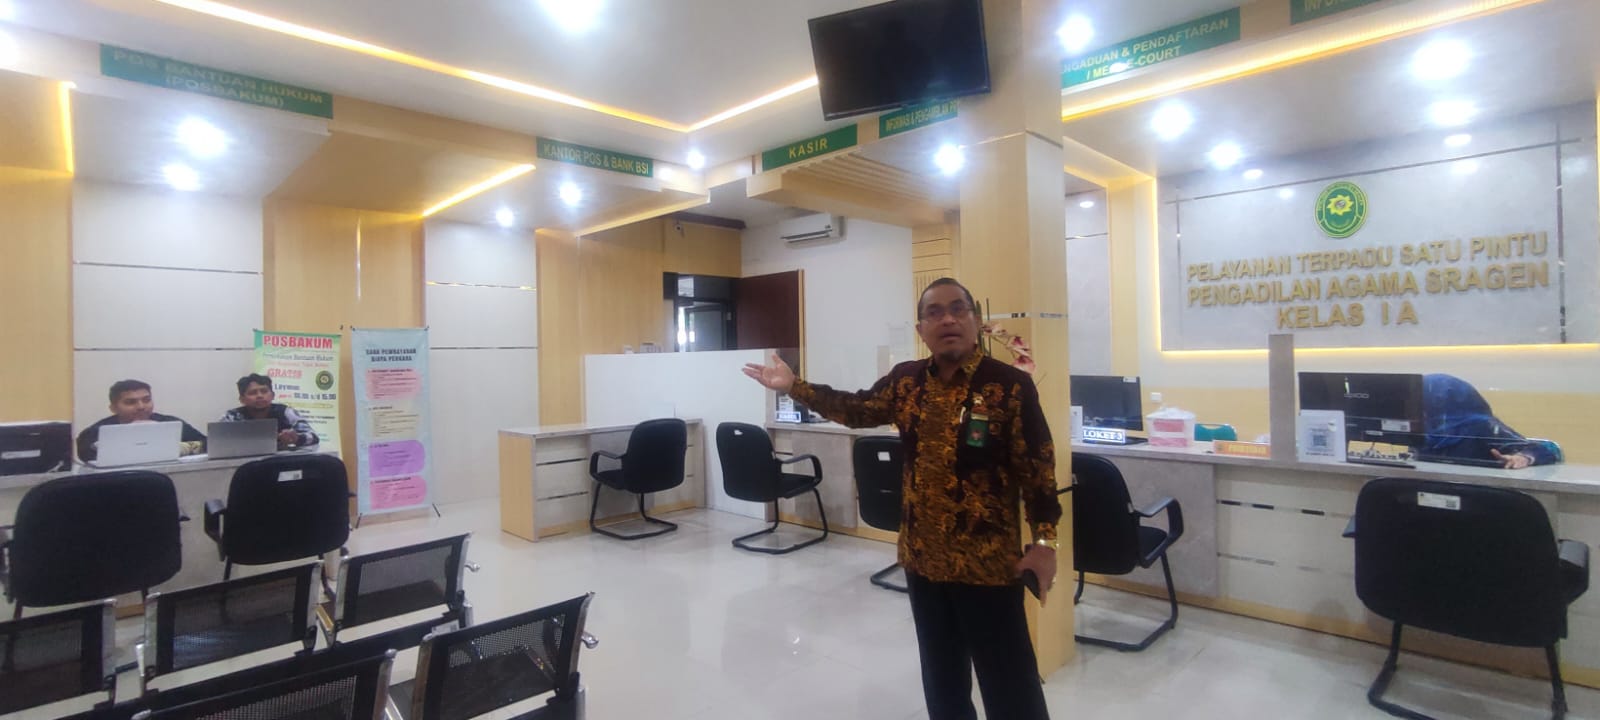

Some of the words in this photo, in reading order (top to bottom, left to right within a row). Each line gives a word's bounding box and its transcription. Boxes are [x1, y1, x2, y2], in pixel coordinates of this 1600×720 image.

[1063, 49, 1119, 73] NGADUAN
[1121, 47, 1130, 58] &
[1132, 17, 1229, 54] PENDAFTARAN
[164, 62, 257, 91] BANTUAN
[261, 81, 323, 104] HUKUM
[166, 76, 285, 108] (POSBAKUM)
[543, 144, 582, 162] KANTOR
[583, 152, 601, 166] POS
[603, 156, 610, 168] &
[611, 156, 634, 171] BANK
[635, 161, 649, 175] BSI
[788, 137, 828, 160] KASIR
[1186, 255, 1292, 282] PELAYANAN
[1296, 246, 1393, 274] TERPADU
[1400, 239, 1462, 266] SATU
[1470, 231, 1548, 261] PINTU
[1187, 277, 1321, 307] PENGADILAN
[1326, 271, 1419, 300] AGAMA
[1425, 260, 1549, 294] SRAGEN
[1276, 302, 1365, 330] KELAS
[1396, 300, 1420, 326] A
[263, 335, 333, 349] POSBAKUM
[1083, 429, 1115, 440] LOKET
